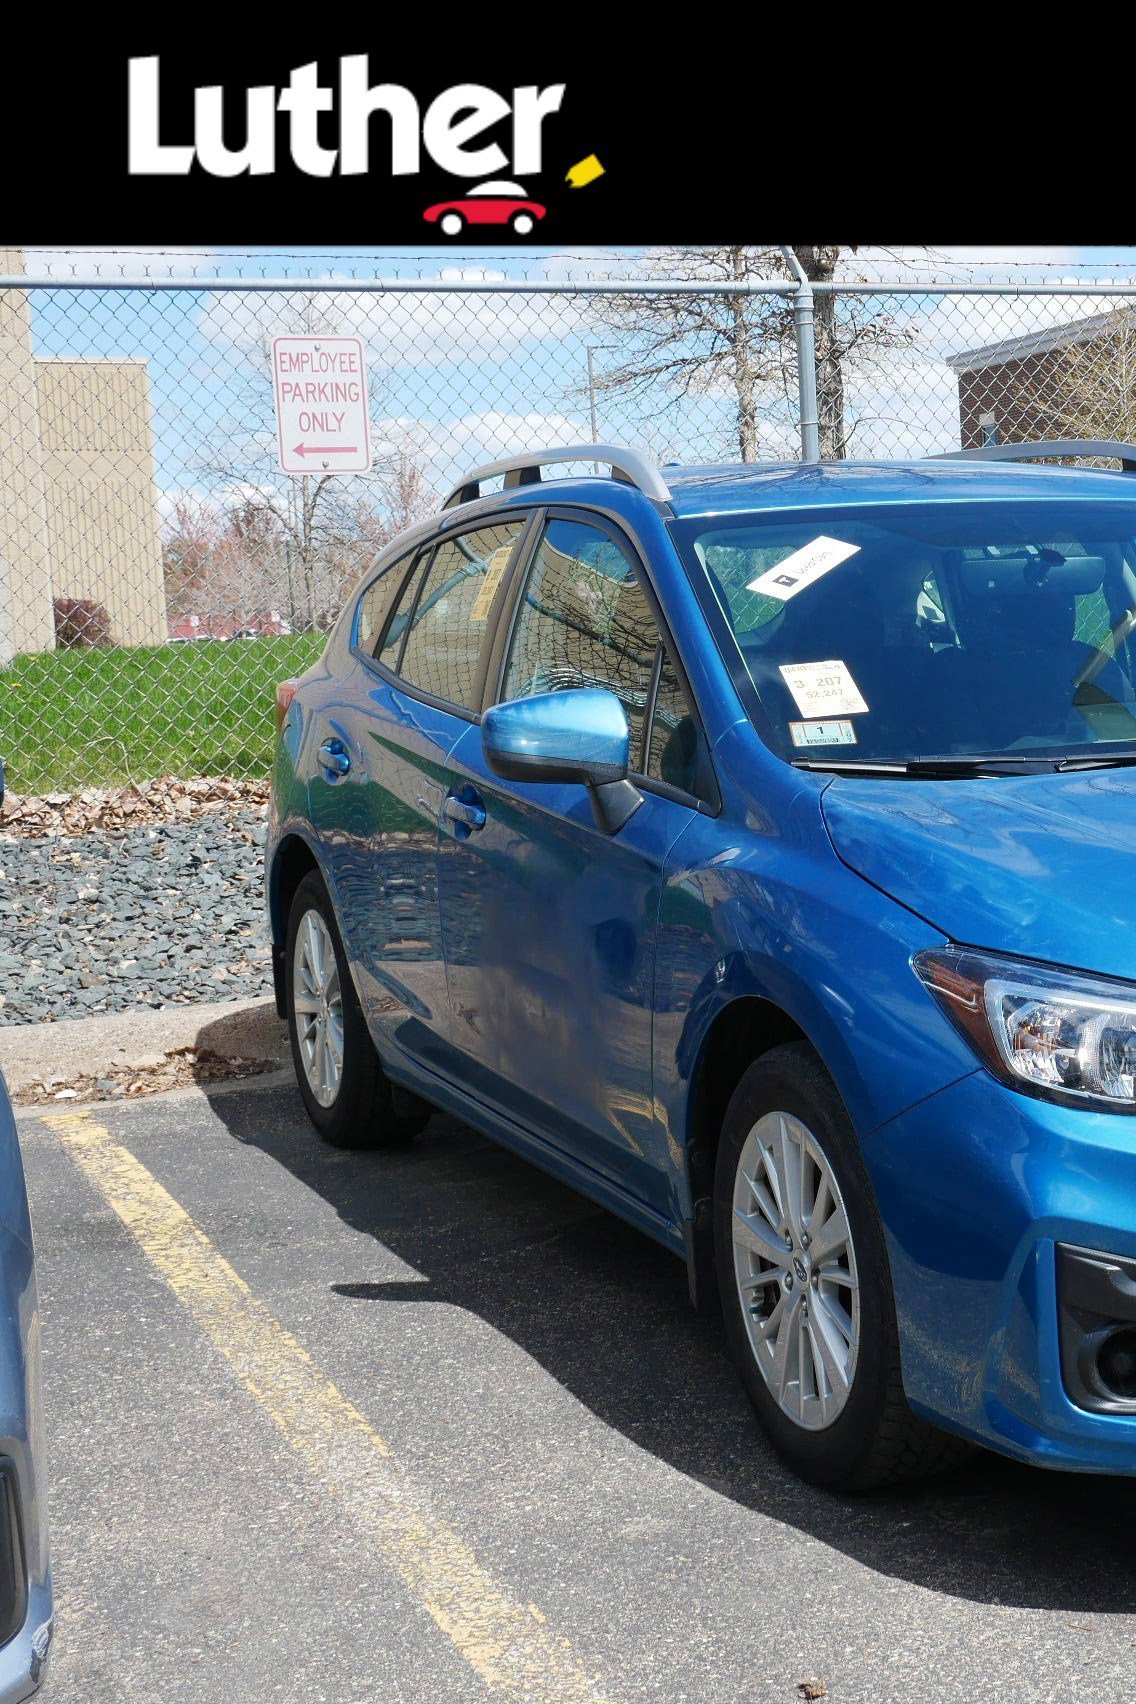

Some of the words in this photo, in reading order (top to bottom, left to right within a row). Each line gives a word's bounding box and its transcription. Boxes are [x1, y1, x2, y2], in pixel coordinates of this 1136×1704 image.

[279, 352, 359, 373] EMPLOYEE
[281, 382, 360, 403] PARKING
[298, 412, 346, 432] ONLY
